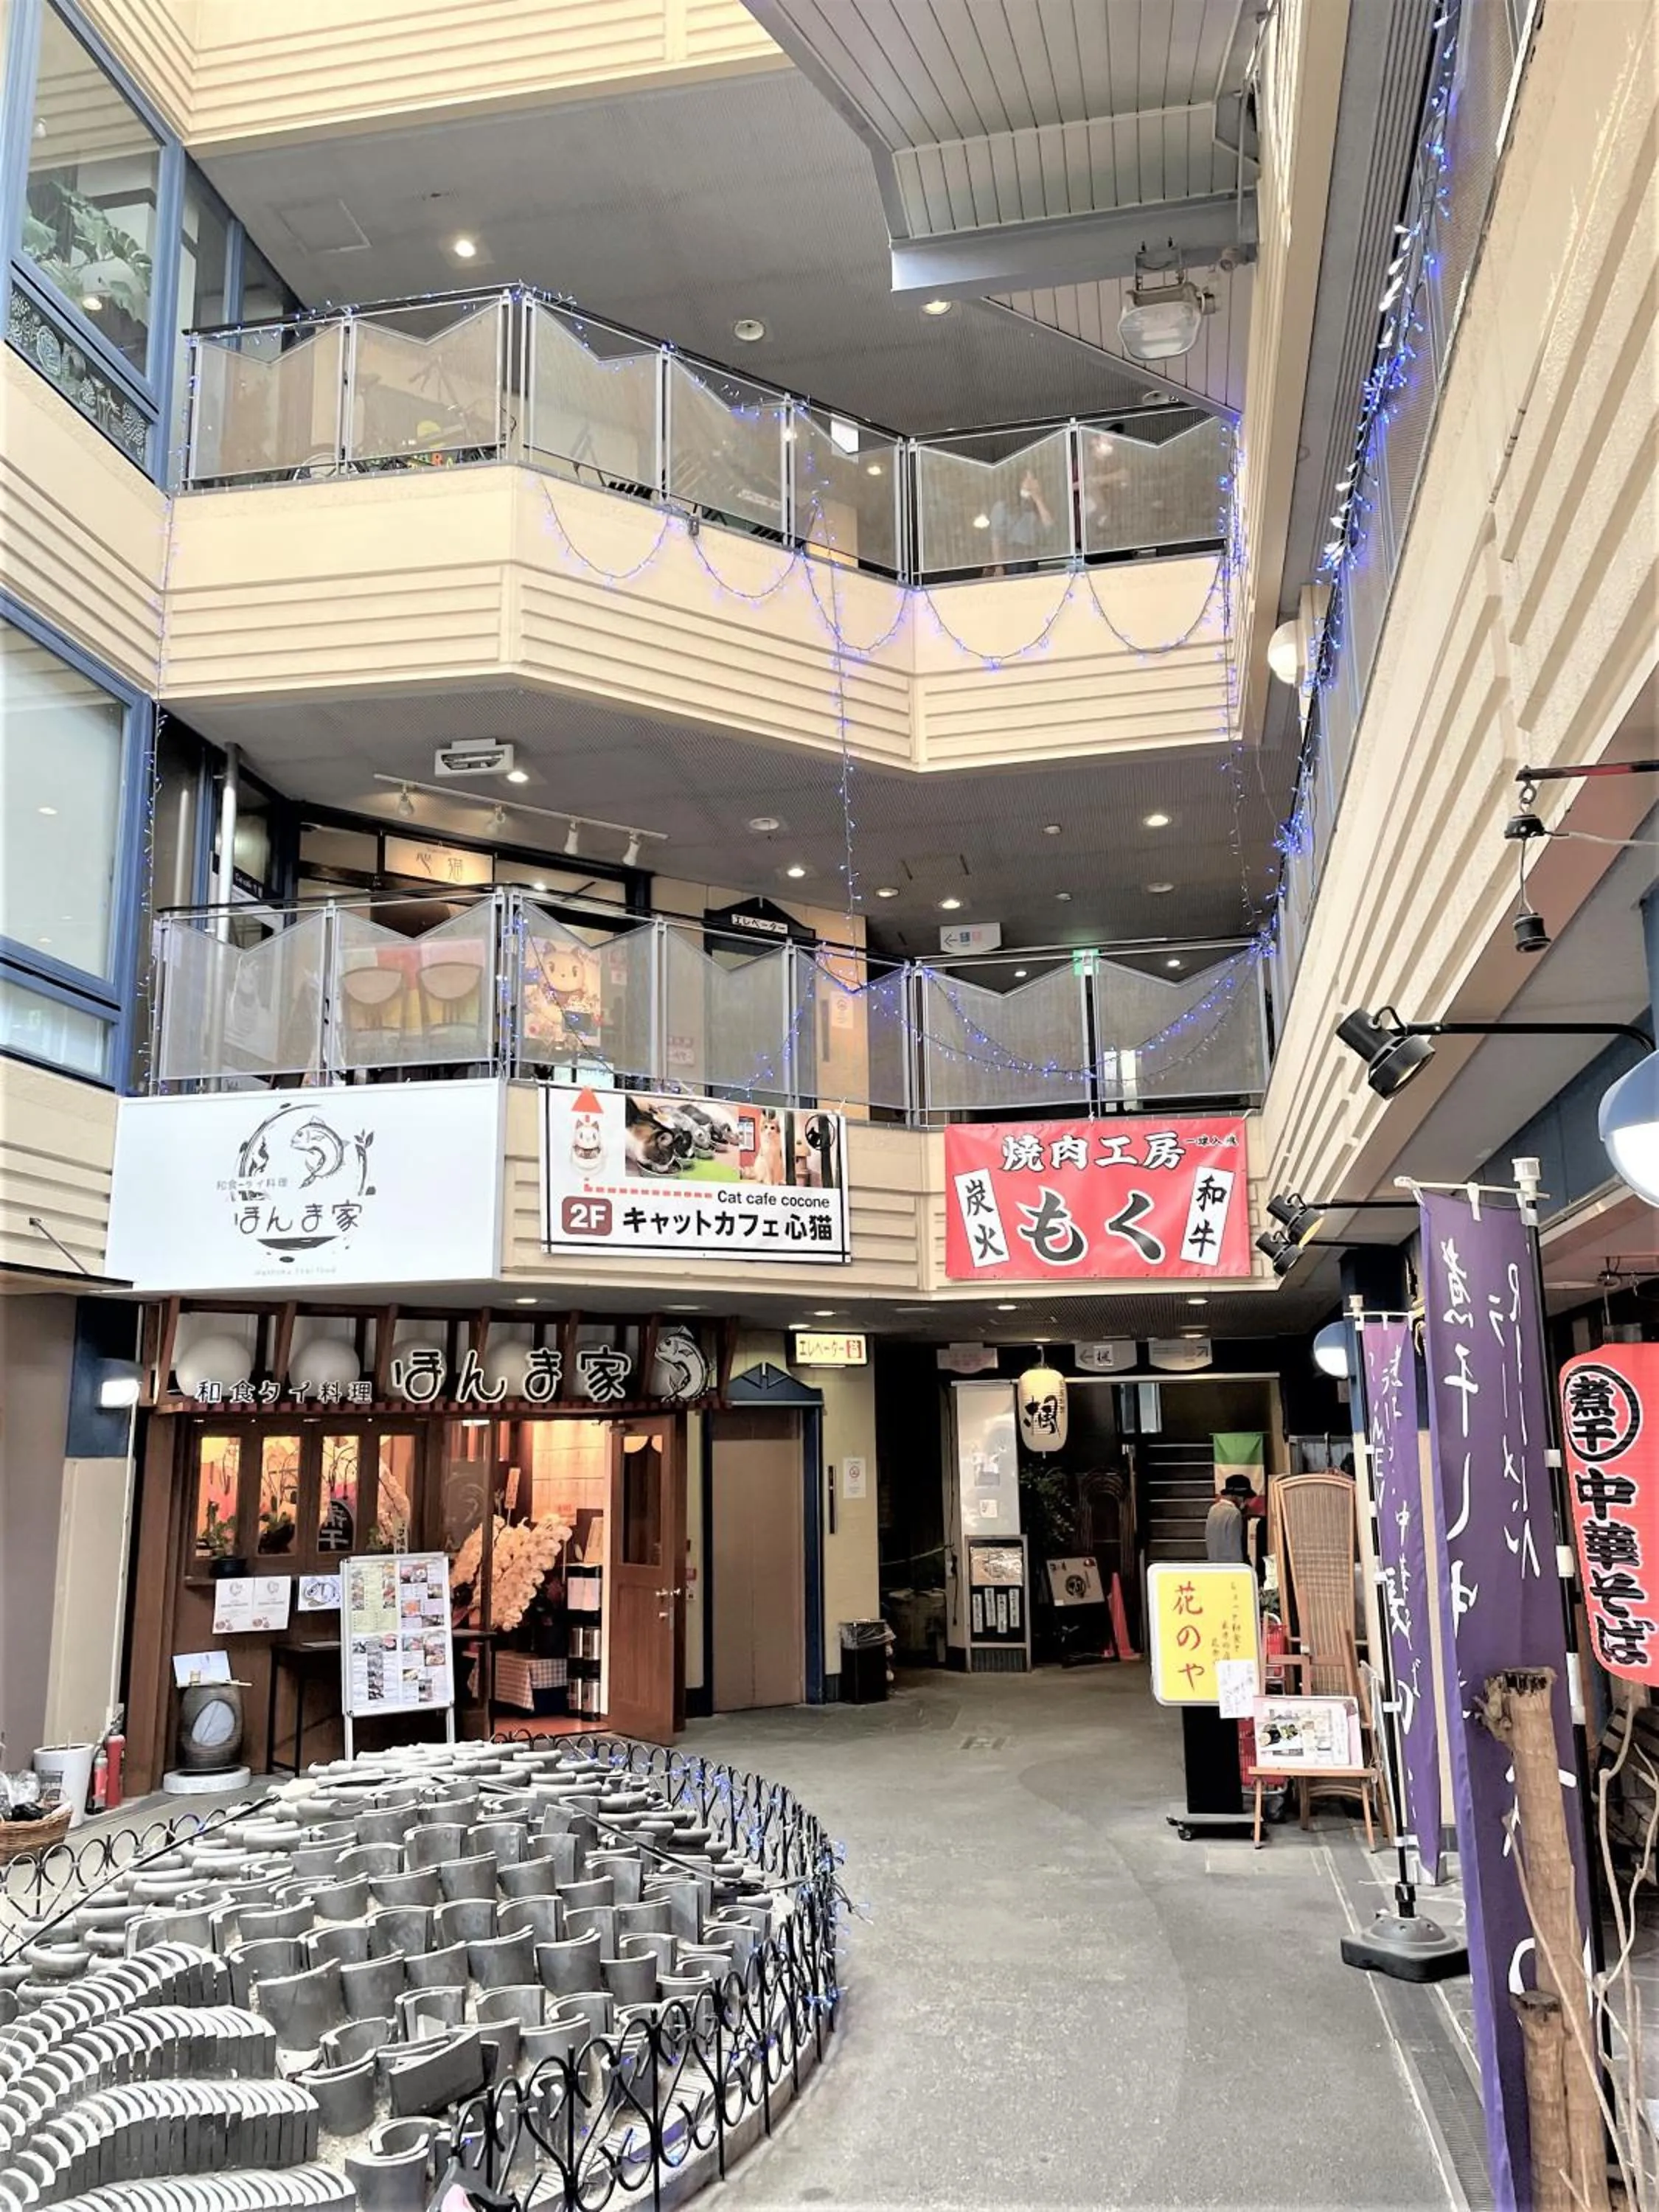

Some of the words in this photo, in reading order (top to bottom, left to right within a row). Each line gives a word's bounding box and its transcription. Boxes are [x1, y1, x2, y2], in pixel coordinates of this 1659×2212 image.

[737, 917, 785, 931] エレベーター
[1001, 1131, 1186, 1172] 焼肉工房
[233, 1199, 363, 1234] ほんま家
[569, 1203, 608, 1229] 2F
[623, 1206, 833, 1241] キャットカフェ心猫
[717, 1190, 742, 1205] Cat
[746, 1192, 776, 1206] cafe
[781, 1196, 830, 1209] cocone
[966, 1180, 1005, 1260] 炭火
[1188, 1175, 1227, 1258] 和牛
[1016, 1186, 1165, 1266] もく
[195, 1380, 372, 1405] 和食タイ料理
[392, 1344, 632, 1403] ほんま家
[1570, 1374, 1617, 1453] 煮干
[1576, 1467, 1656, 1666] 中華そば
[1172, 1580, 1206, 1691] 花のや
